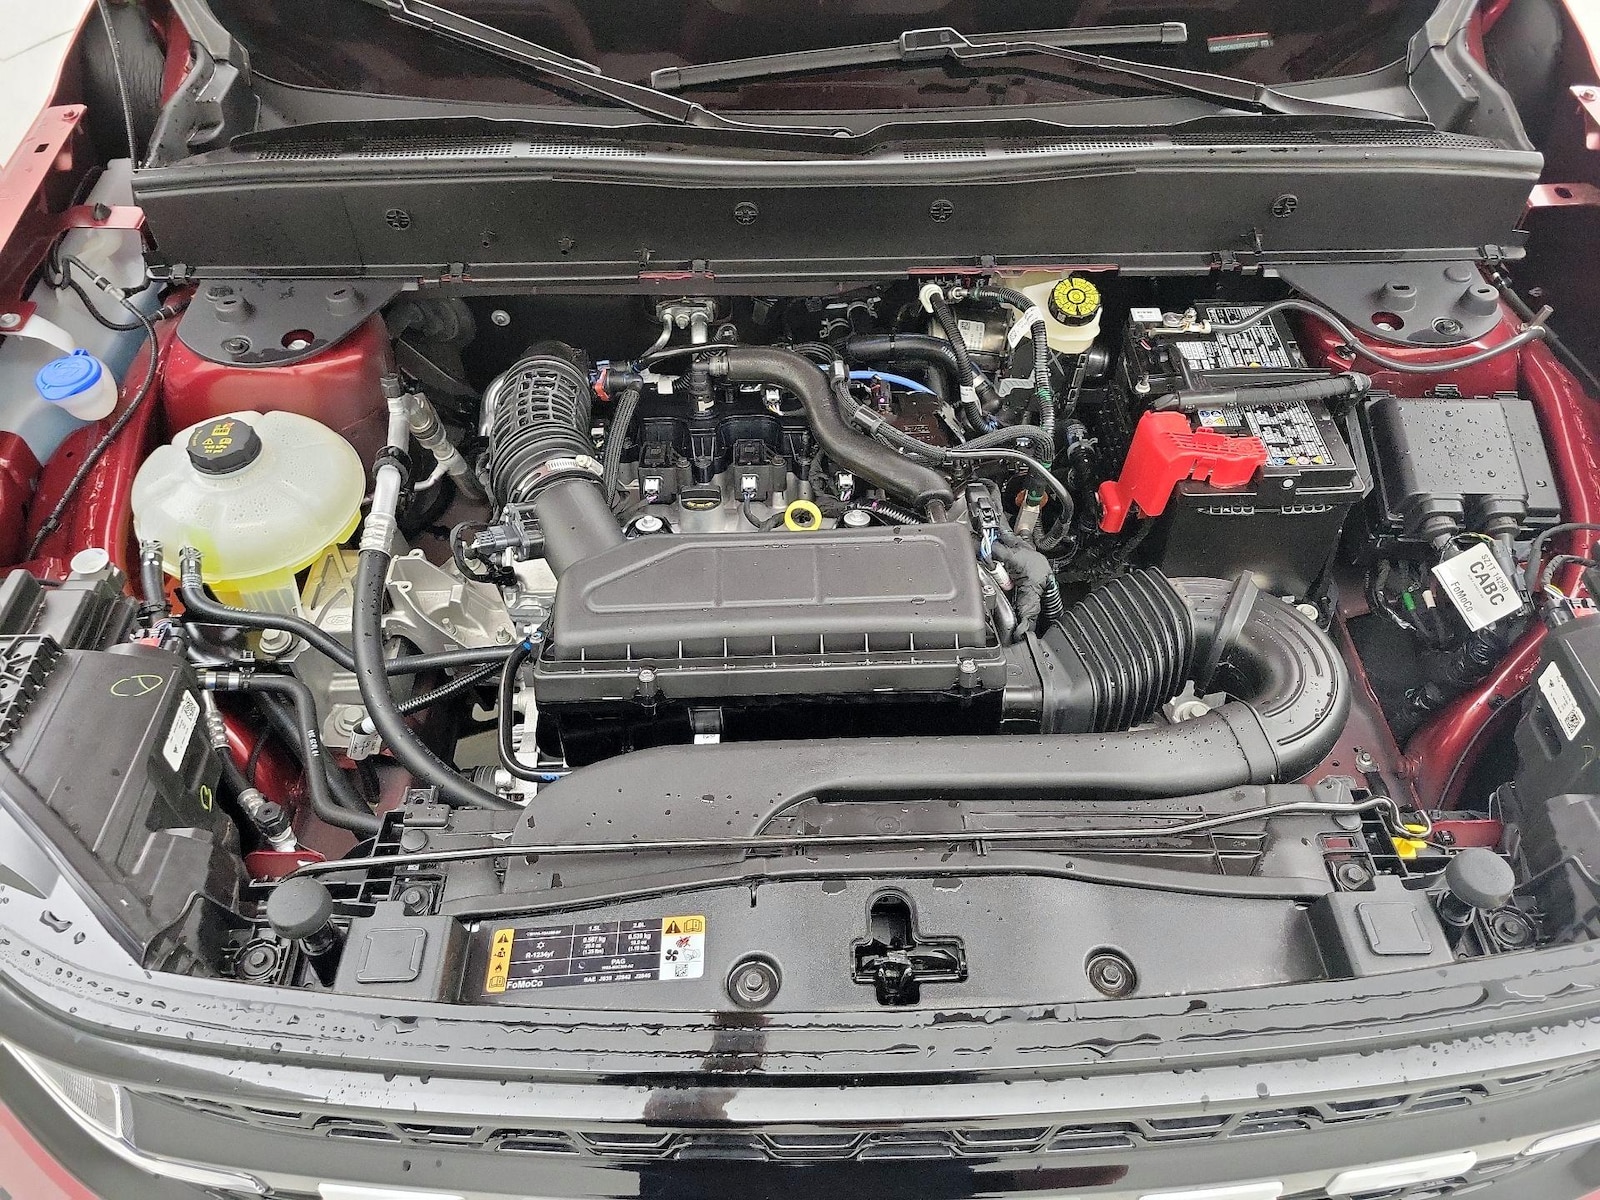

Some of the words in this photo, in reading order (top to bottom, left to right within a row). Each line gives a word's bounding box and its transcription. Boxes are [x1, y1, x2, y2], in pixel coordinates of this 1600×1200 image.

[1469, 561, 1505, 606] CABC
[1450, 581, 1474, 612] FoMoCo
[525, 951, 555, 959] R-1234yf
[506, 980, 544, 989] FoMoCo
